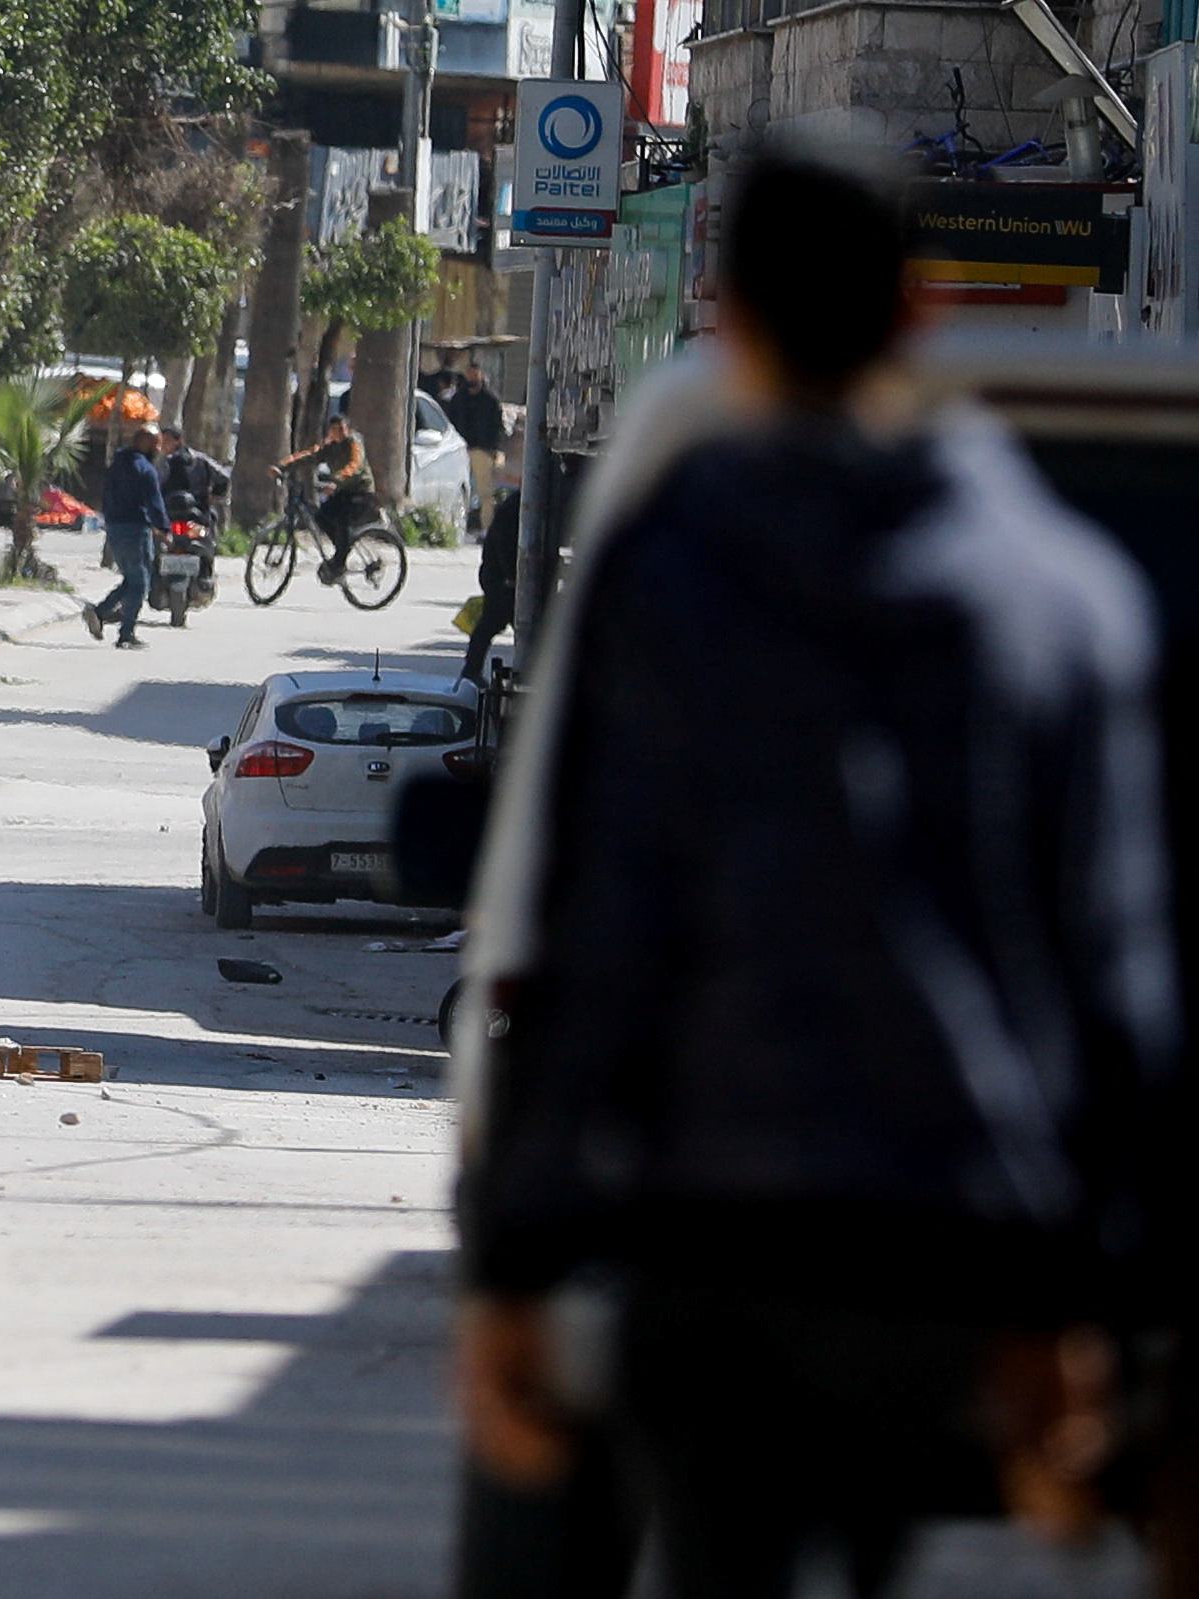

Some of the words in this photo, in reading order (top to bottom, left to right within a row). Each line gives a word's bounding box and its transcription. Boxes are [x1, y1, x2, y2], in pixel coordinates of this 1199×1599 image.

[534, 164, 601, 181] الاتصالات
[534, 180, 601, 197] Paltel
[569, 216, 598, 232] وكيل
[918, 213, 996, 232] Western
[999, 216, 1052, 234] Union
